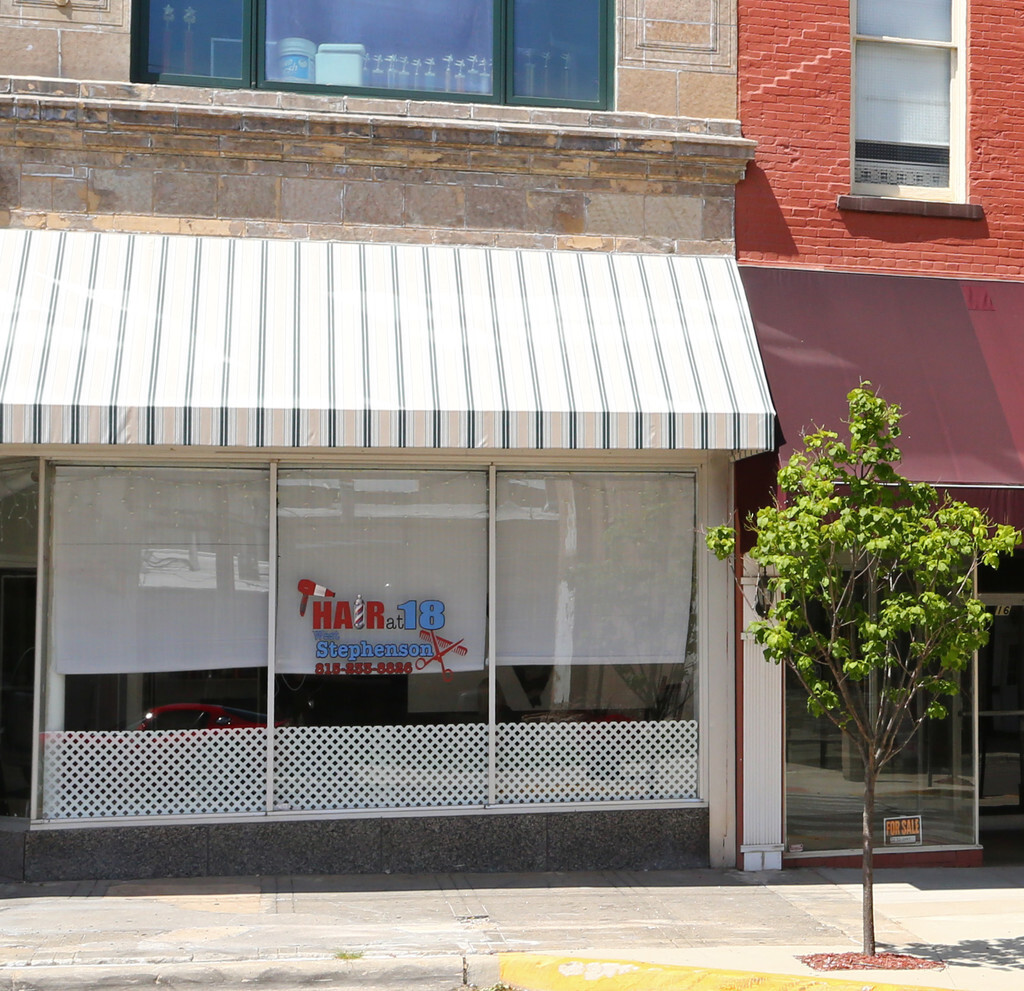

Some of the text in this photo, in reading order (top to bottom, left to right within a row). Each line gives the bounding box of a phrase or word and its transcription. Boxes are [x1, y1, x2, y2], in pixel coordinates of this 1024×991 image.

[312, 595, 445, 630] HAIR at 18
[313, 631, 340, 641] West
[316, 641, 434, 661] Stephenson
[886, 819, 919, 836] FOR SALE
